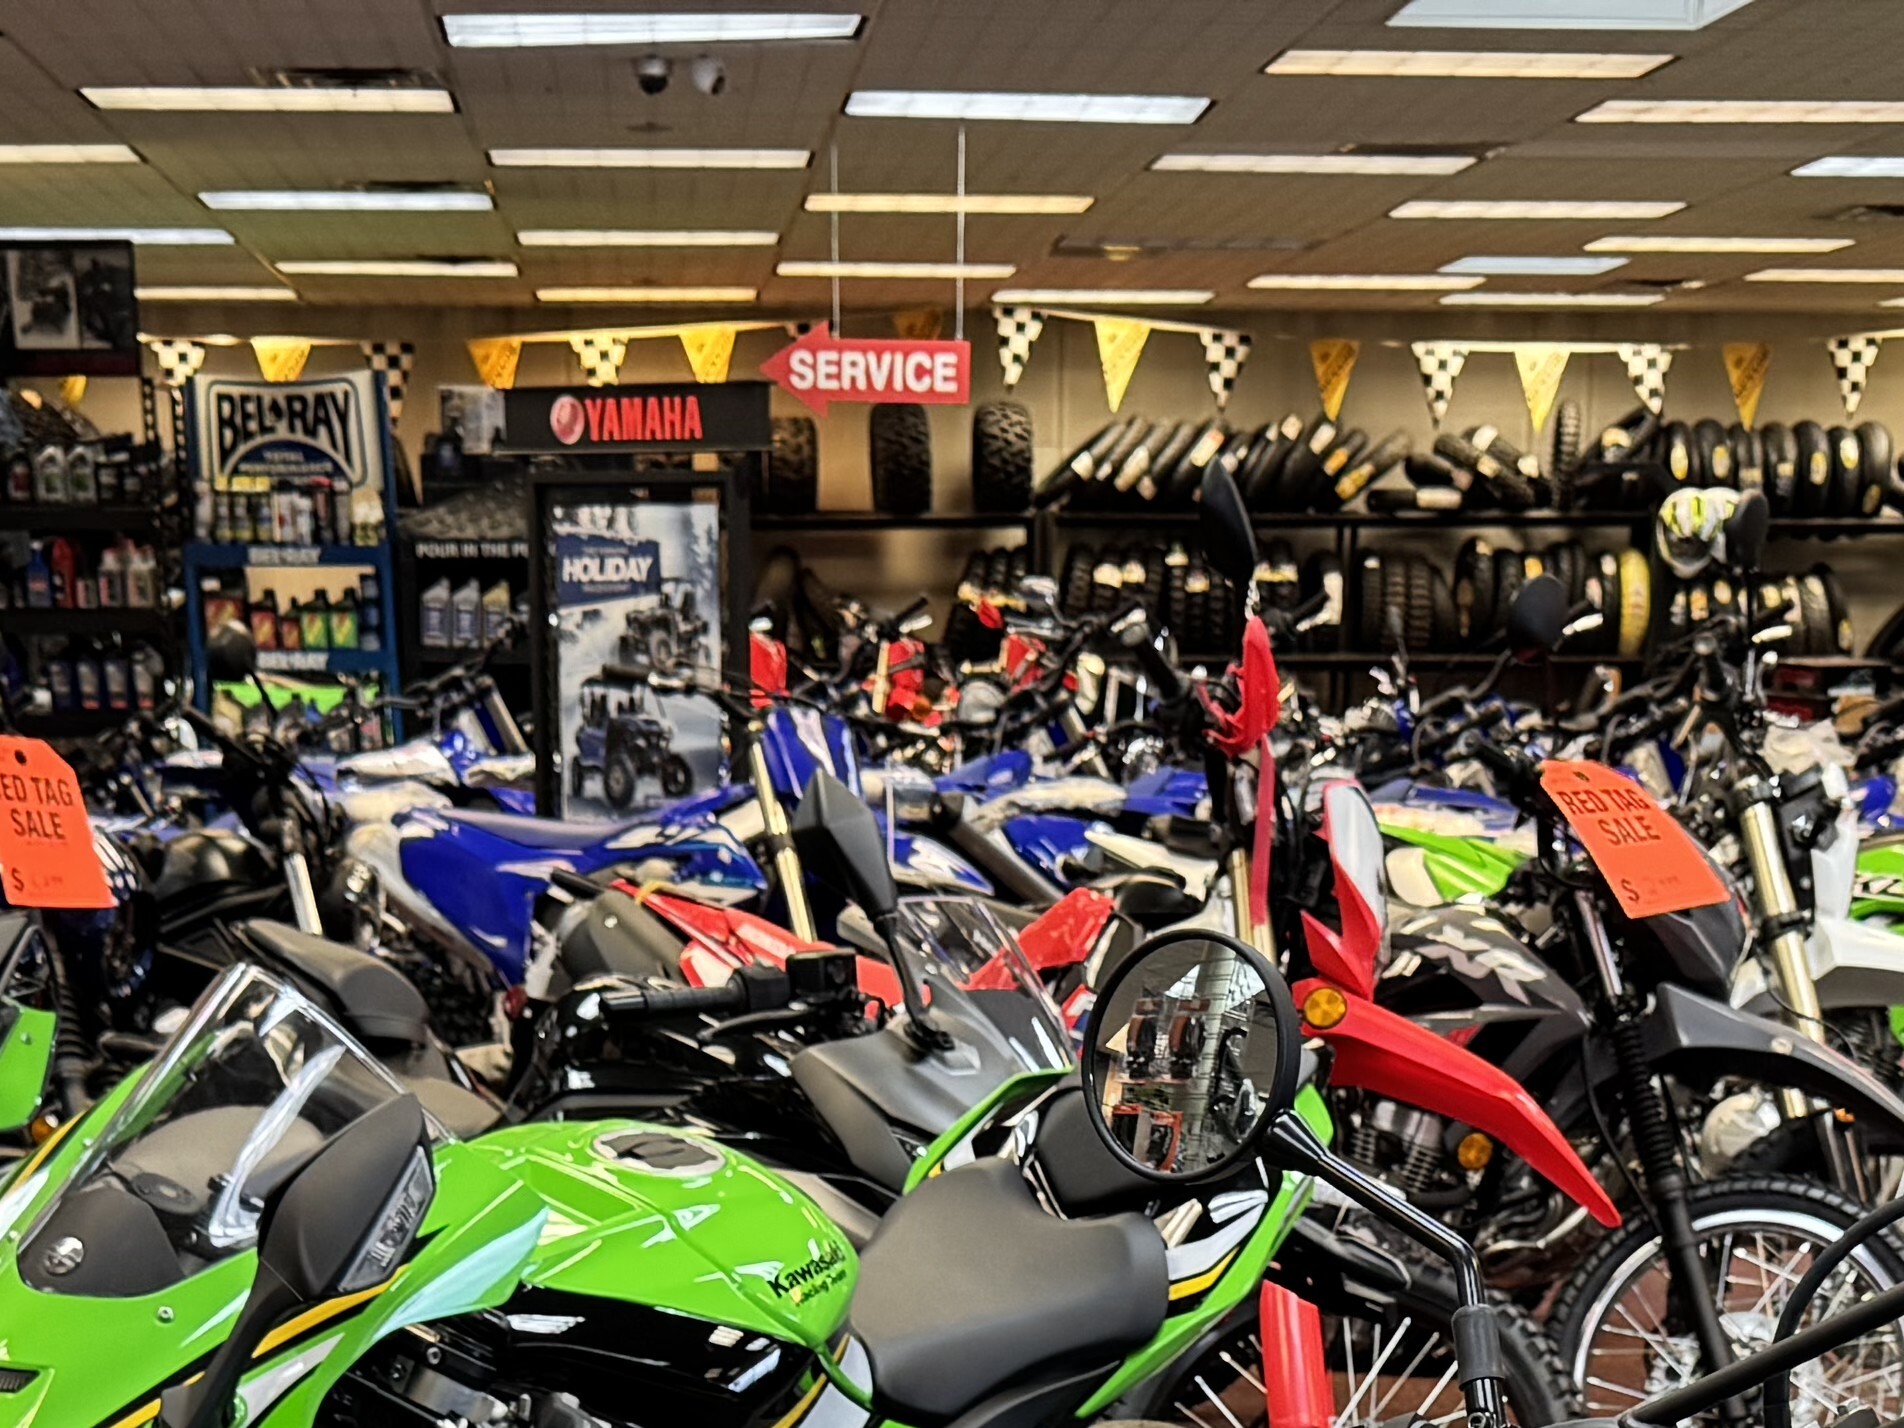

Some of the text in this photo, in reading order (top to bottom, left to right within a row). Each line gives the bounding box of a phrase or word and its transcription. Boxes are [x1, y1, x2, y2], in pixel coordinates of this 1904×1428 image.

[788, 349, 958, 393] SERVICE
[585, 395, 703, 441] YAMAHA
[562, 555, 653, 583] HOLIDAY
[30, 777, 73, 807] TAG
[1556, 788, 1650, 815] RED TAG
[10, 808, 67, 840] SALE
[1598, 815, 1660, 847] SALE
